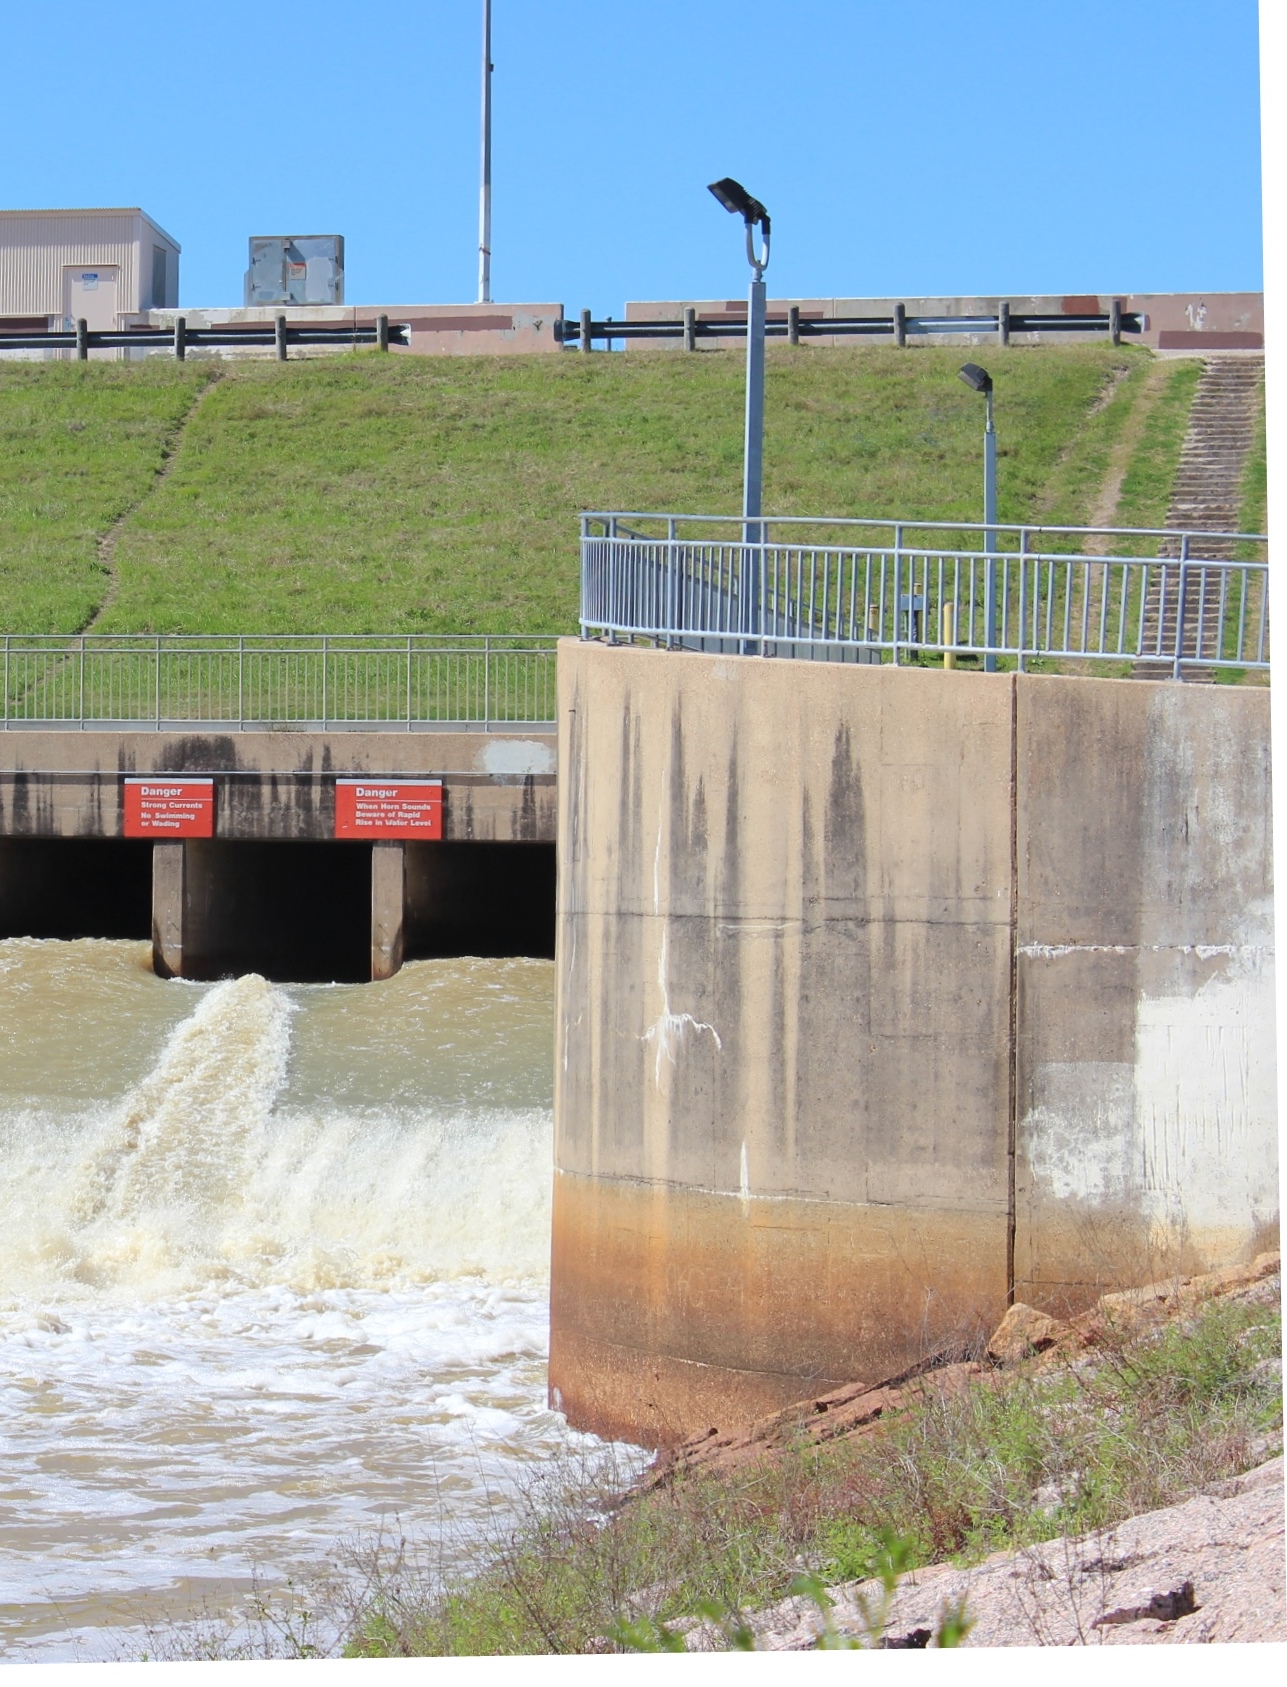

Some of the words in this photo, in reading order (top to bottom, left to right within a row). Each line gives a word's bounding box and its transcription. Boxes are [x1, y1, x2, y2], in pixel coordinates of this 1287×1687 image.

[140, 786, 182, 797] Danger
[355, 787, 398, 798] Danger
[140, 801, 167, 809] Strong
[155, 812, 195, 820] Swimming
